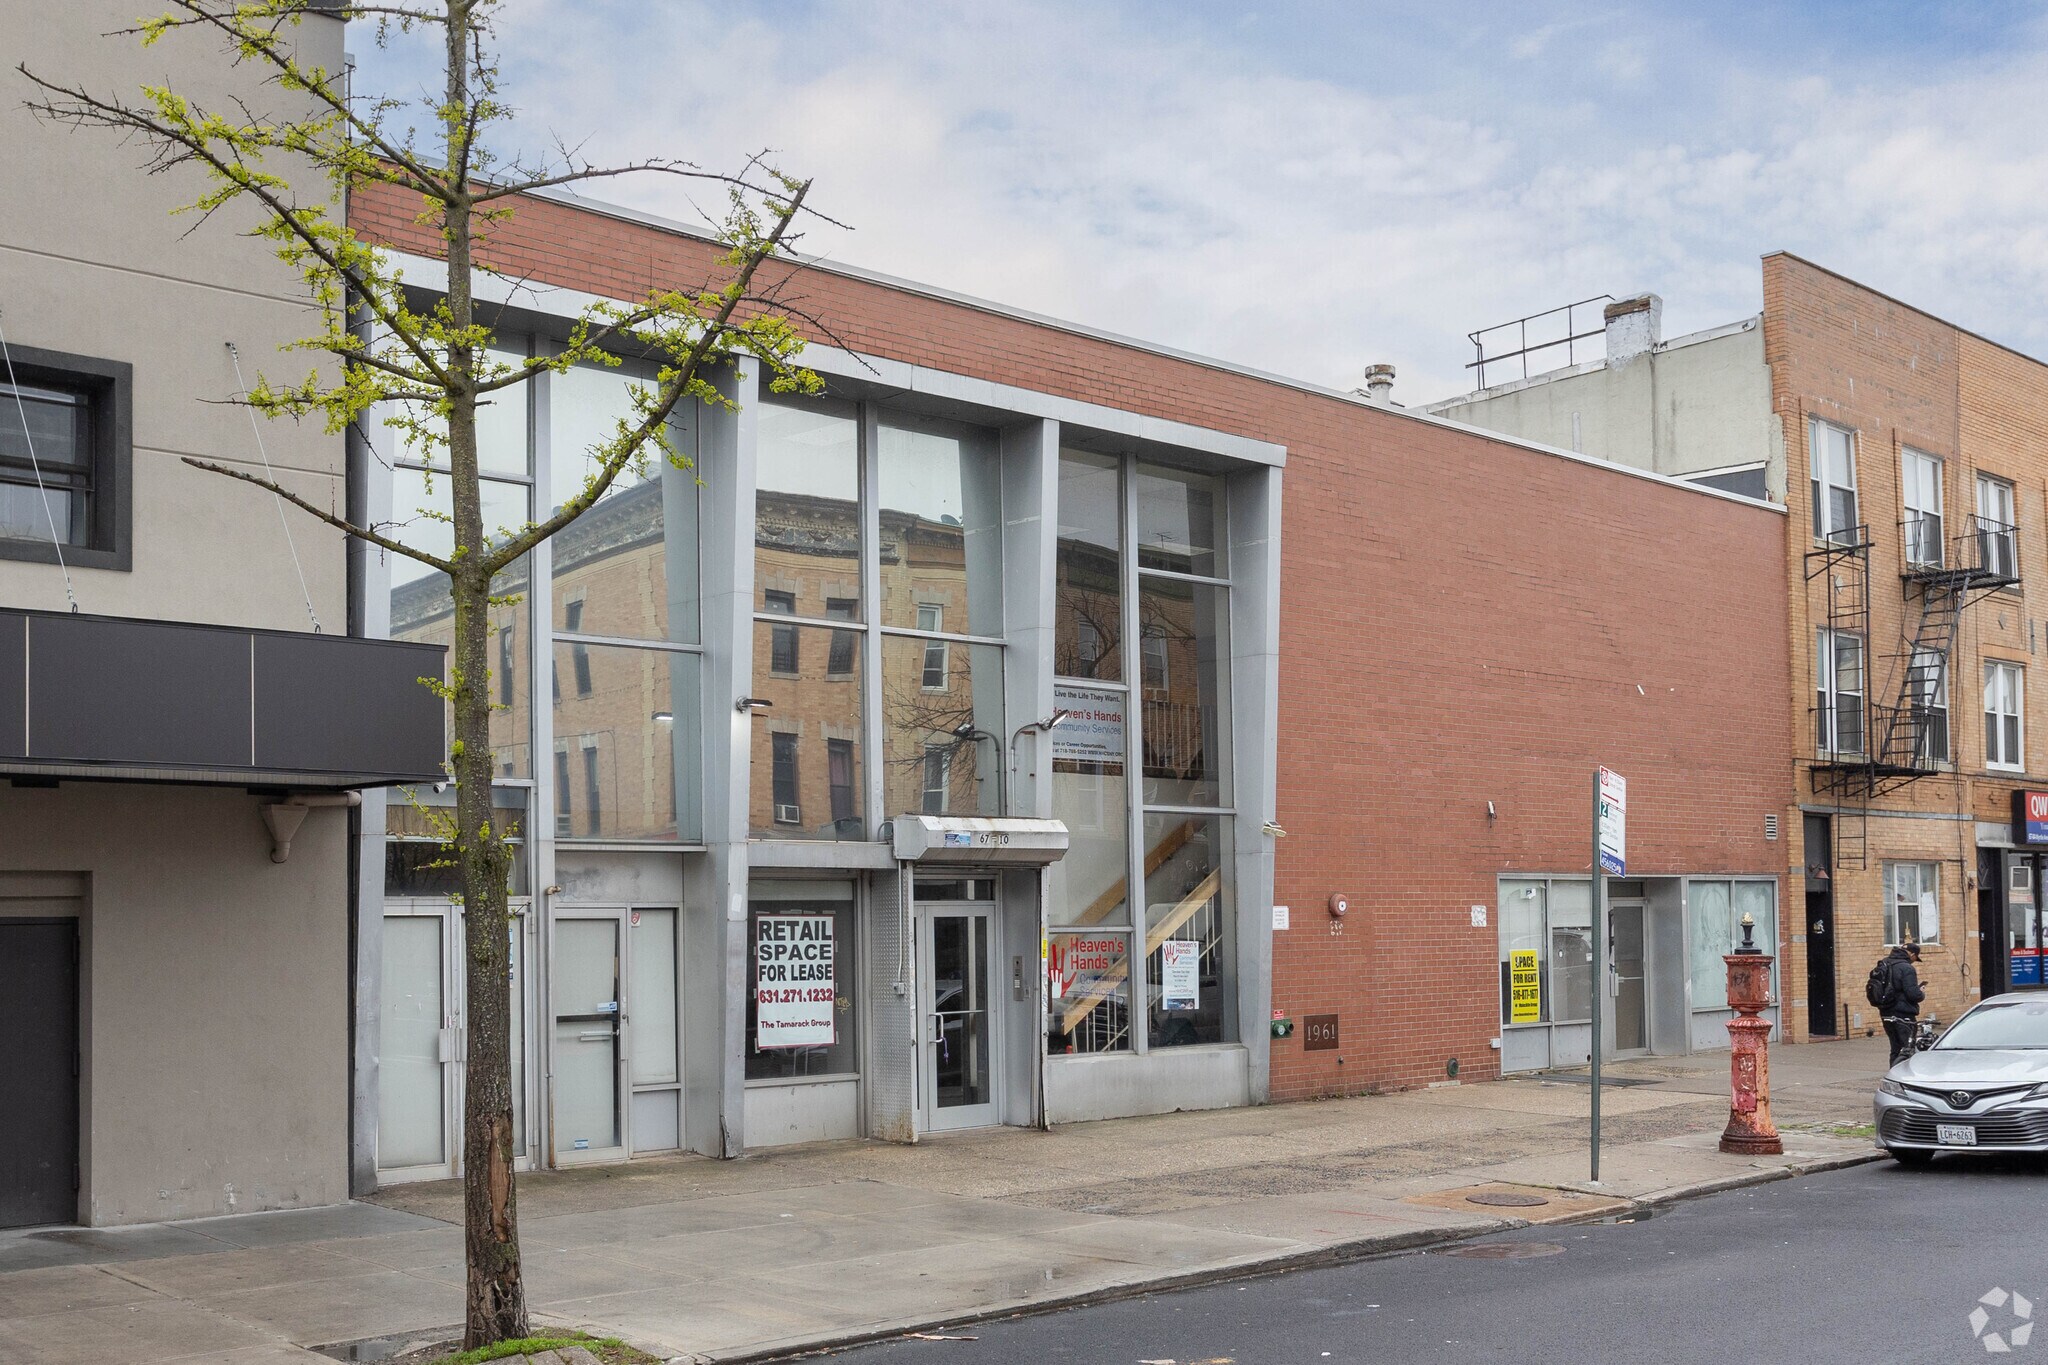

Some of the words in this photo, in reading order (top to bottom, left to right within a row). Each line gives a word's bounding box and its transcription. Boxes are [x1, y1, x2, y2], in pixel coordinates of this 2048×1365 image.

[1054, 690, 1067, 698] Live
[1068, 691, 1077, 699] the
[1078, 692, 1089, 700] Life
[1090, 693, 1104, 703] They
[1094, 709, 1122, 723] Hands
[1053, 722, 1091, 735] ommunity
[1092, 723, 1122, 736] Services
[758, 920, 832, 941] RETAIL
[759, 944, 832, 961] SPACE
[1070, 936, 1124, 953] Heaven's
[1070, 953, 1109, 970] Hands
[1514, 956, 1534, 968] SPACE
[758, 964, 787, 982] FOR
[790, 963, 832, 981] LEASE
[1513, 973, 1524, 984] FOR
[1524, 972, 1537, 983] RENT
[759, 988, 833, 1004] 631.271.1232
[760, 1020, 775, 1029] The
[776, 1018, 810, 1029] Tamarack
[810, 1018, 831, 1029] Group
[1307, 1023, 1335, 1041] 1961
